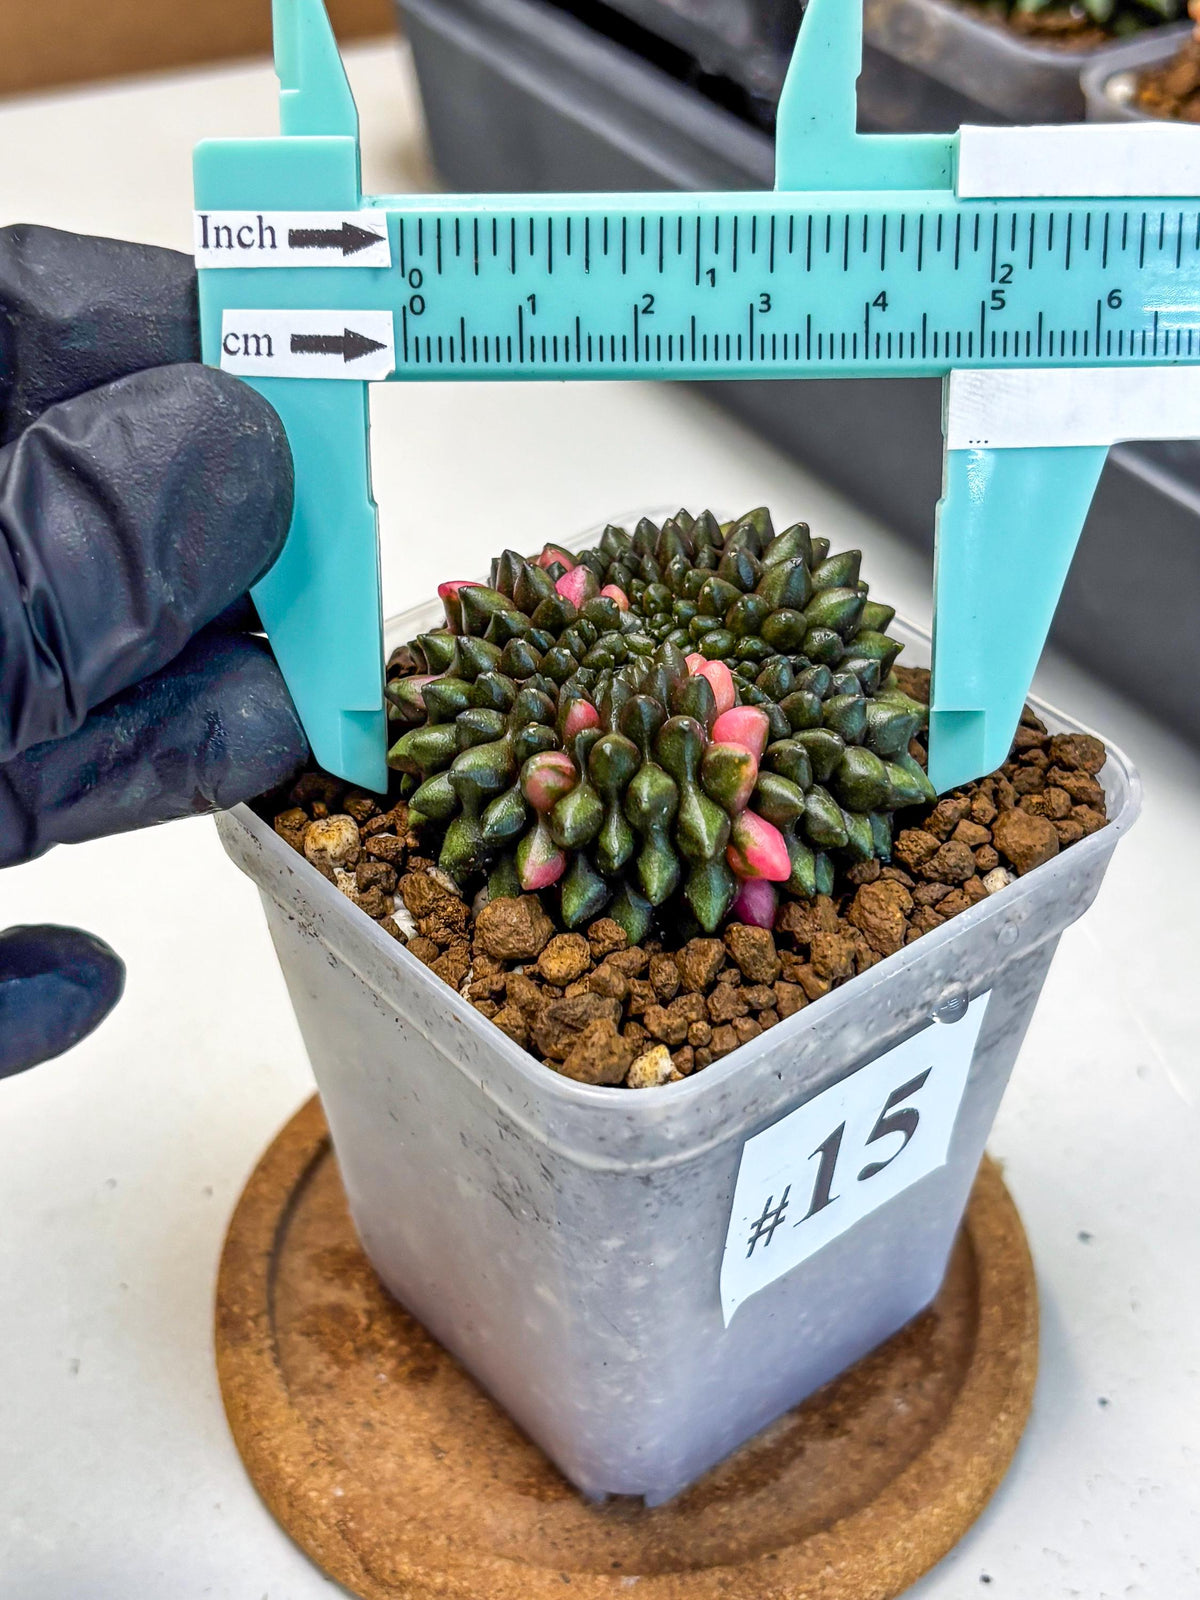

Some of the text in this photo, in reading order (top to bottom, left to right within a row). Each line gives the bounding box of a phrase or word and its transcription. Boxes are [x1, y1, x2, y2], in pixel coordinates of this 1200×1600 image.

[199, 214, 278, 251] Inch
[408, 263, 1014, 290] 0 1 2
[409, 288, 1123, 316] 0 1 2 3 4 5 6
[222, 331, 275, 357] cm
[745, 1065, 934, 1260] #15
